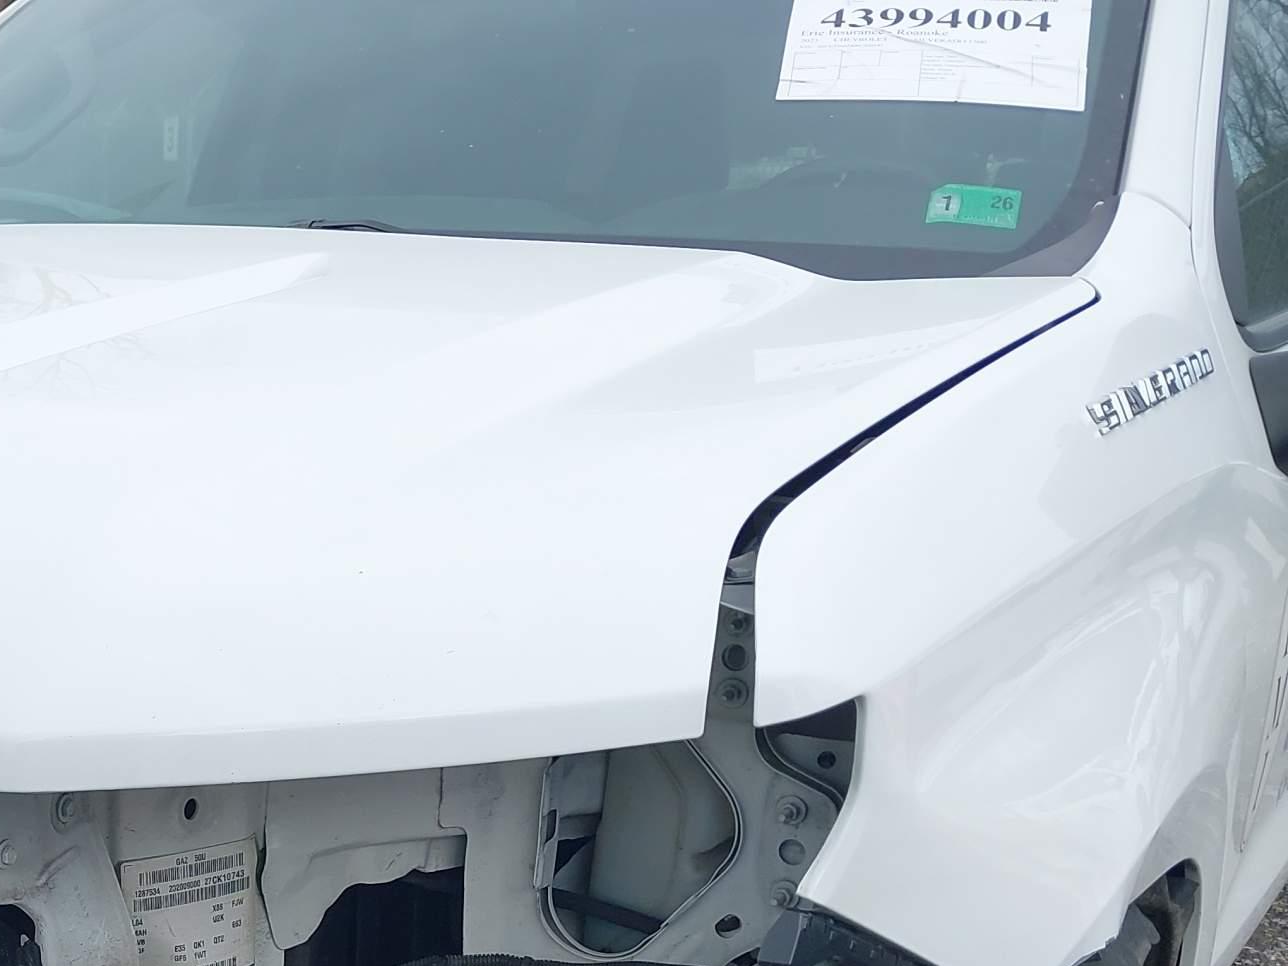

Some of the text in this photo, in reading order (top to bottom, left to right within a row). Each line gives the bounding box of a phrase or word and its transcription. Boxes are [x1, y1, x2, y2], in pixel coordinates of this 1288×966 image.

[820, 7, 1052, 32] 43994004
[941, 194, 1015, 211] 1 26
[1085, 348, 1215, 437] SILVERADO
[204, 869, 245, 886] 27CK10743
